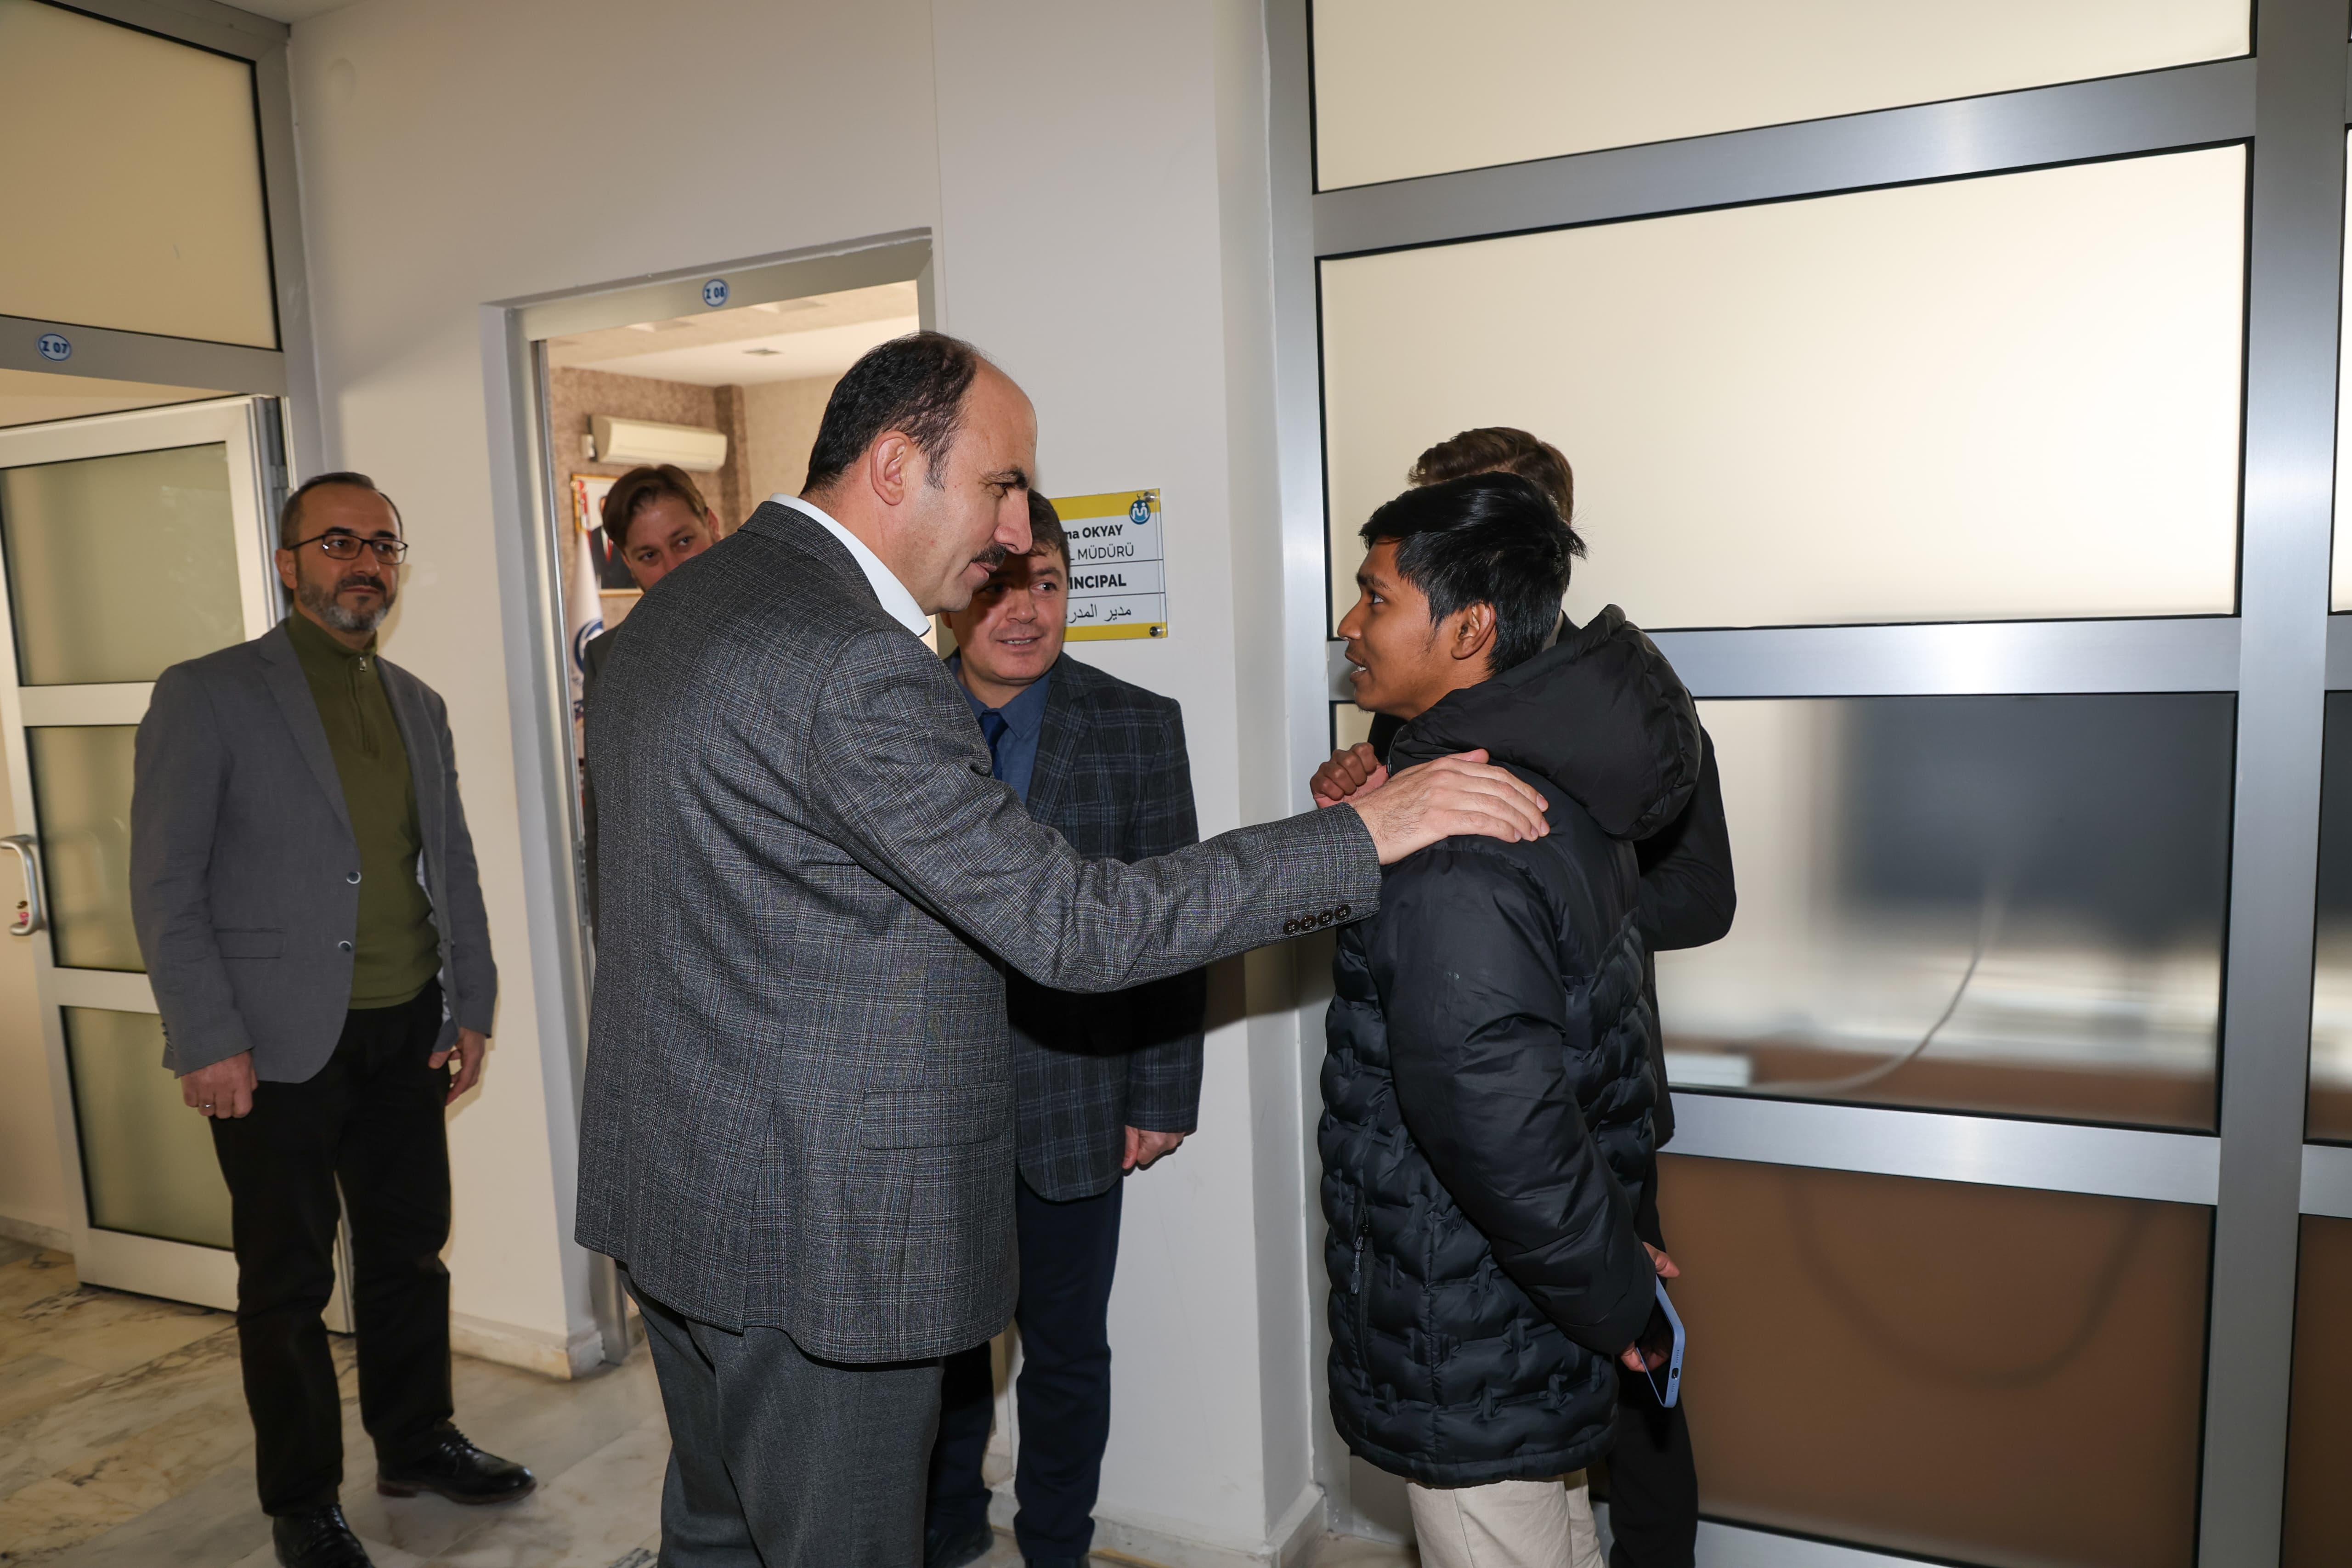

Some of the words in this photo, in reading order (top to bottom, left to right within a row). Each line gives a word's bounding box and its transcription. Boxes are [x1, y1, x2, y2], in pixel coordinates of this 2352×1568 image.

[714, 286, 725, 298] 08
[41, 340, 50, 351] Z
[53, 342, 68, 353] 07
[1082, 524, 1123, 538] OKYAY
[1078, 542, 1134, 560] MÜDÜRÜ
[1068, 574, 1127, 590] INCIPAL
[1065, 603, 1098, 623] المدر
[1104, 606, 1132, 622] مدير
